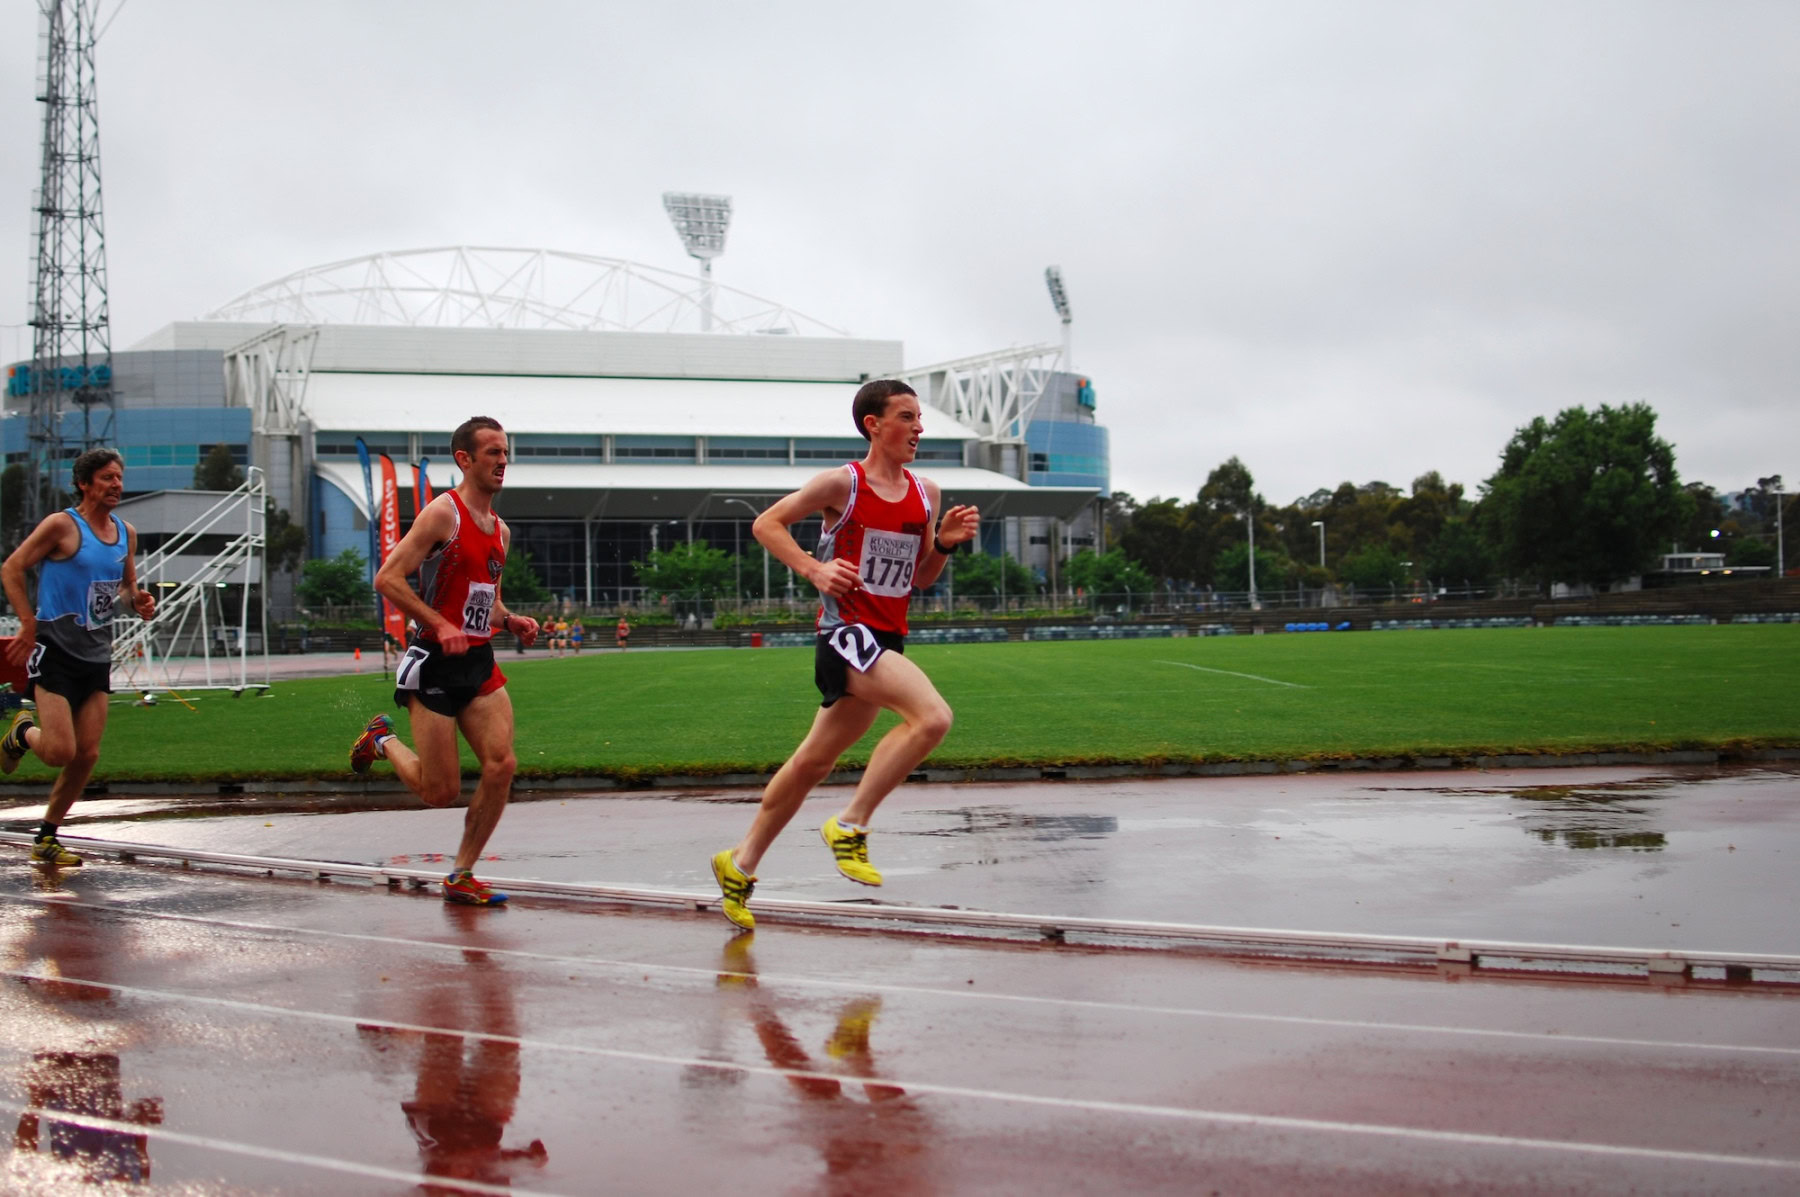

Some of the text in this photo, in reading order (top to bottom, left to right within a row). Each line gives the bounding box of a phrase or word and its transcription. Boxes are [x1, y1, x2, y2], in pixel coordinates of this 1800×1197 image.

[863, 556, 913, 588] 1779
[465, 605, 491, 631] 261
[838, 626, 877, 667] 2
[398, 649, 427, 686] 7
